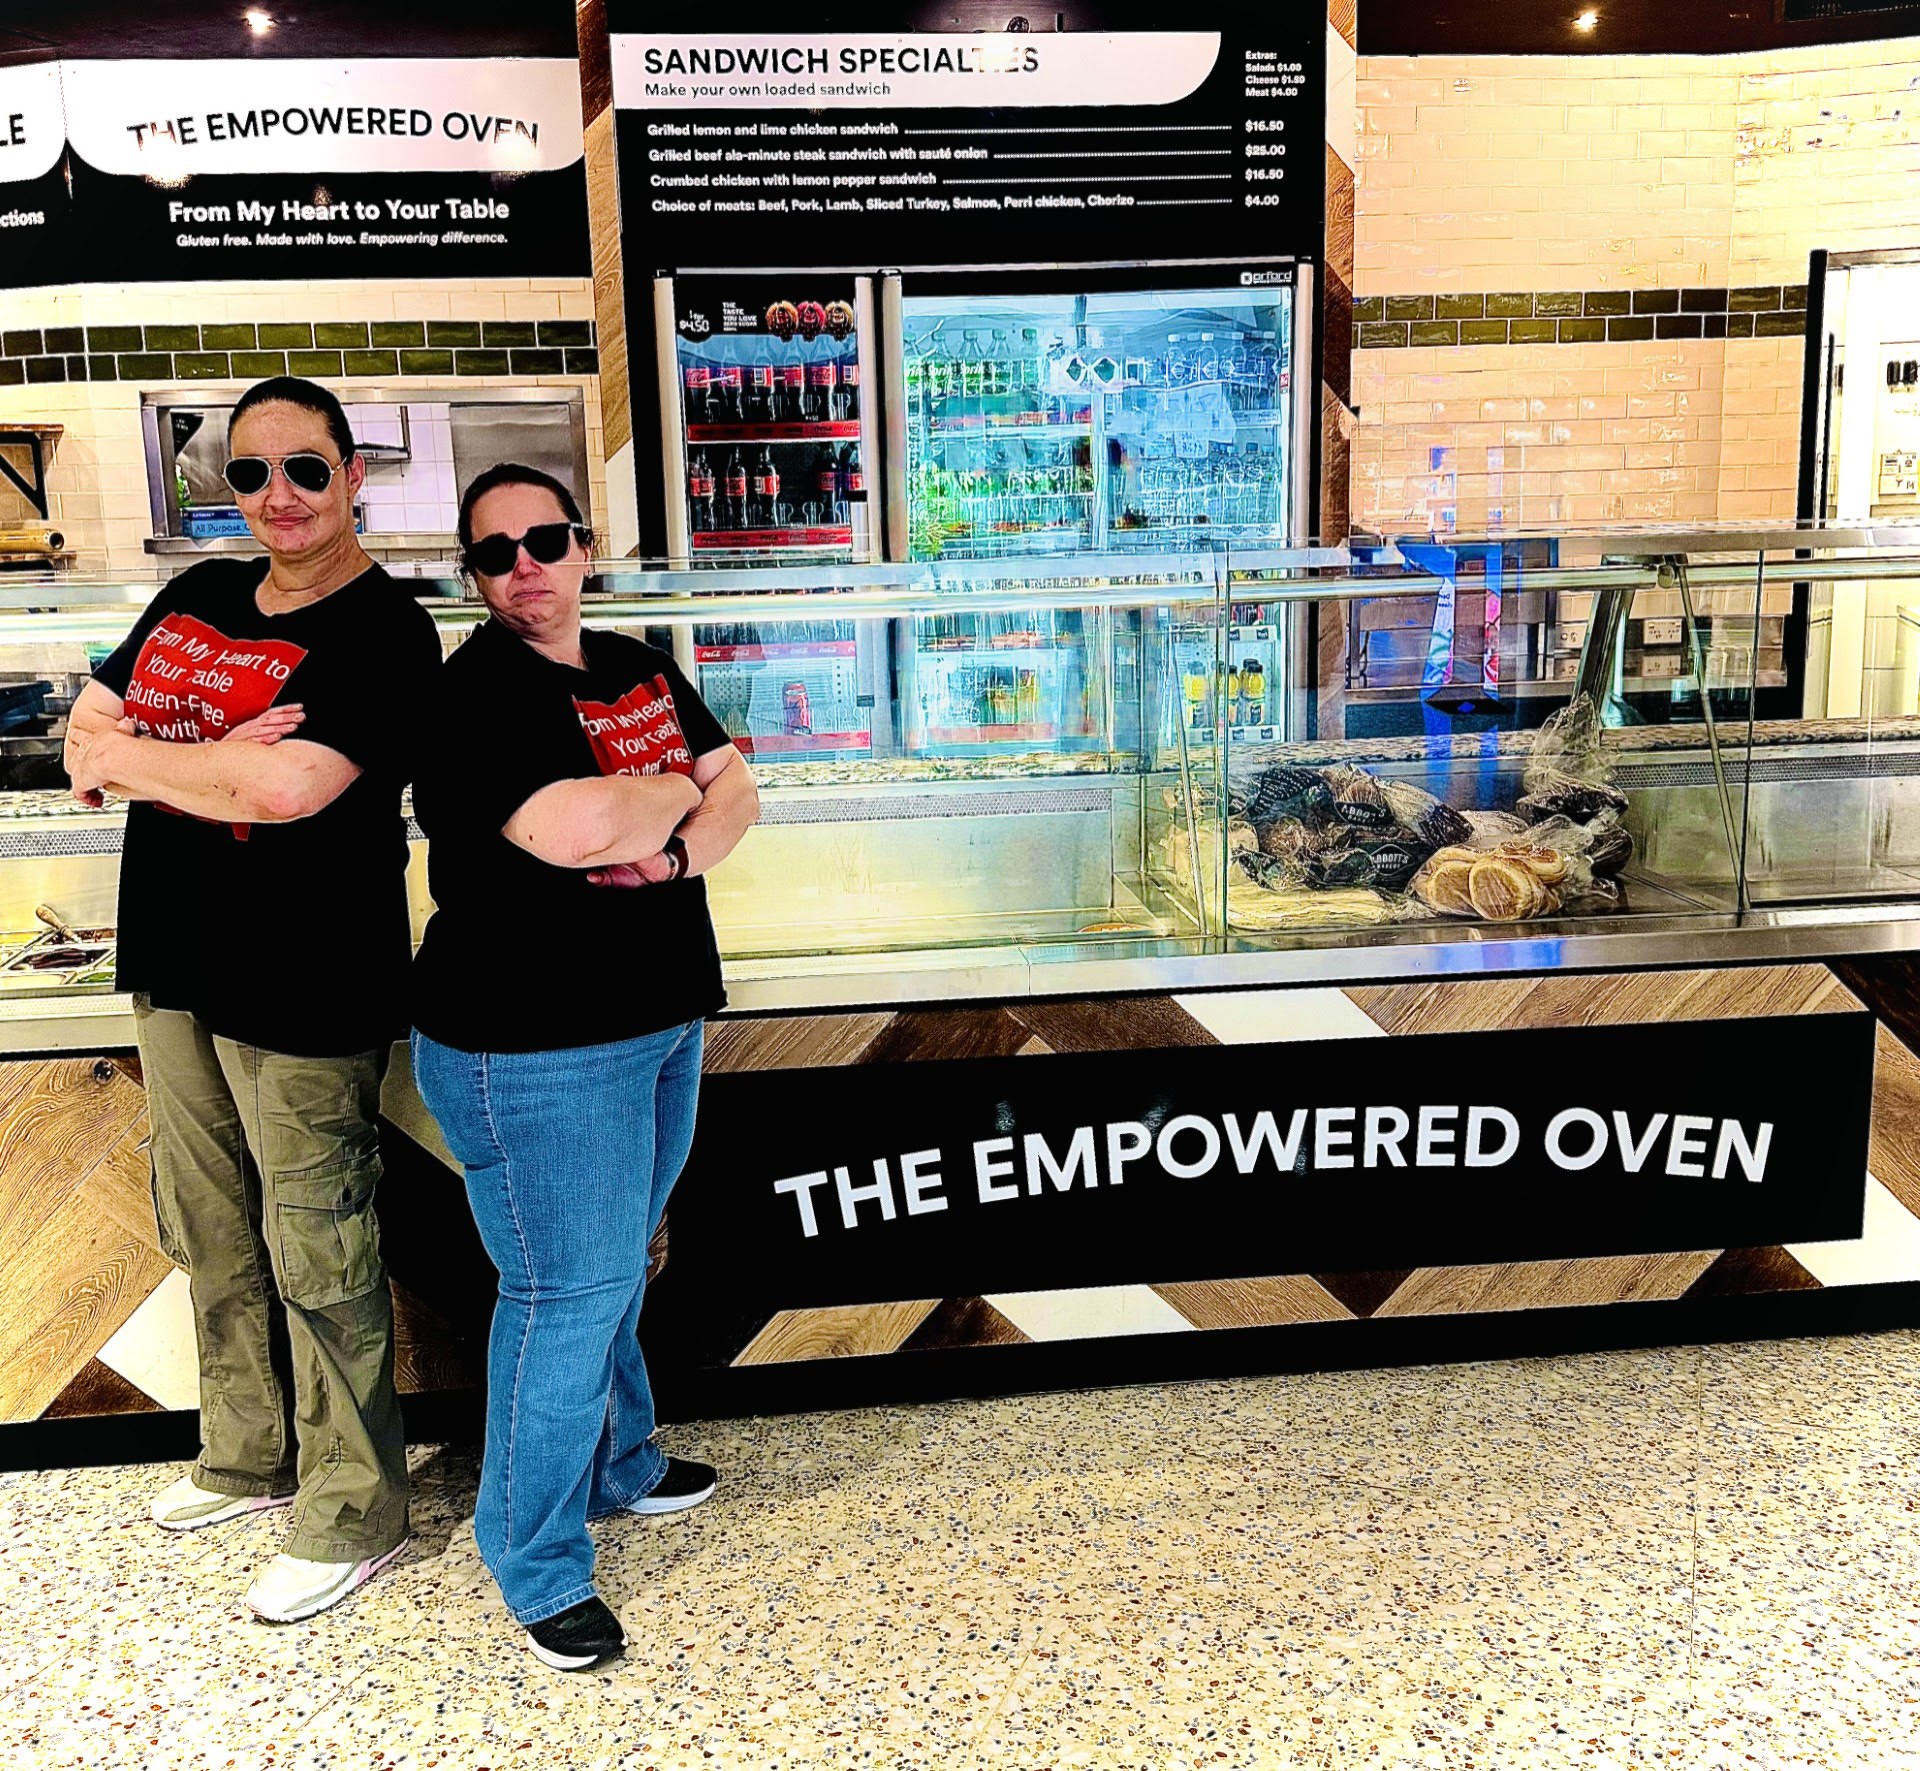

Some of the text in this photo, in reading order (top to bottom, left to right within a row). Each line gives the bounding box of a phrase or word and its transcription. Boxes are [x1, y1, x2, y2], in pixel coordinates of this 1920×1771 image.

[645, 48, 828, 74] SANDWICH
[1246, 51, 1277, 59] Extras:
[1246, 63, 1301, 72] Salads $1.00
[1246, 75, 1279, 84] Cheese
[646, 82, 890, 98] Make your own loaded sandwich
[1246, 87, 1298, 97] Meat $4.00
[126, 116, 198, 150] THE
[207, 108, 432, 140] EMPOWERED
[648, 123, 898, 135] Grilled lemon and lime chicken sandwich
[1246, 120, 1284, 132] $16.50
[649, 149, 691, 161] Grilled
[695, 149, 722, 161] beef
[725, 149, 791, 161] ala-minute
[794, 148, 826, 160] steak
[829, 148, 887, 160] sandwich
[890, 148, 916, 159] with
[954, 147, 987, 159] onion
[1246, 144, 1285, 157] $25.00
[651, 172, 936, 188] Crumbed chicken with lemon pepper sandwich
[1245, 168, 1283, 181] $16.50
[652, 194, 1134, 212] Choice of meats: Beef, Pork, Lamb, Sliced Turkey, Salmon, Perri chicken, Chorizo
[1245, 195, 1279, 207] $4.00
[169, 198, 509, 226] From My Heart to Your Table
[176, 232, 507, 246] Gluten free. Made with love. Empowering difference.
[180, 637, 215, 662] My
[264, 658, 290, 680] to
[144, 653, 234, 692] Your able
[774, 1106, 1773, 1237] THE EMPOWERED OVEN
